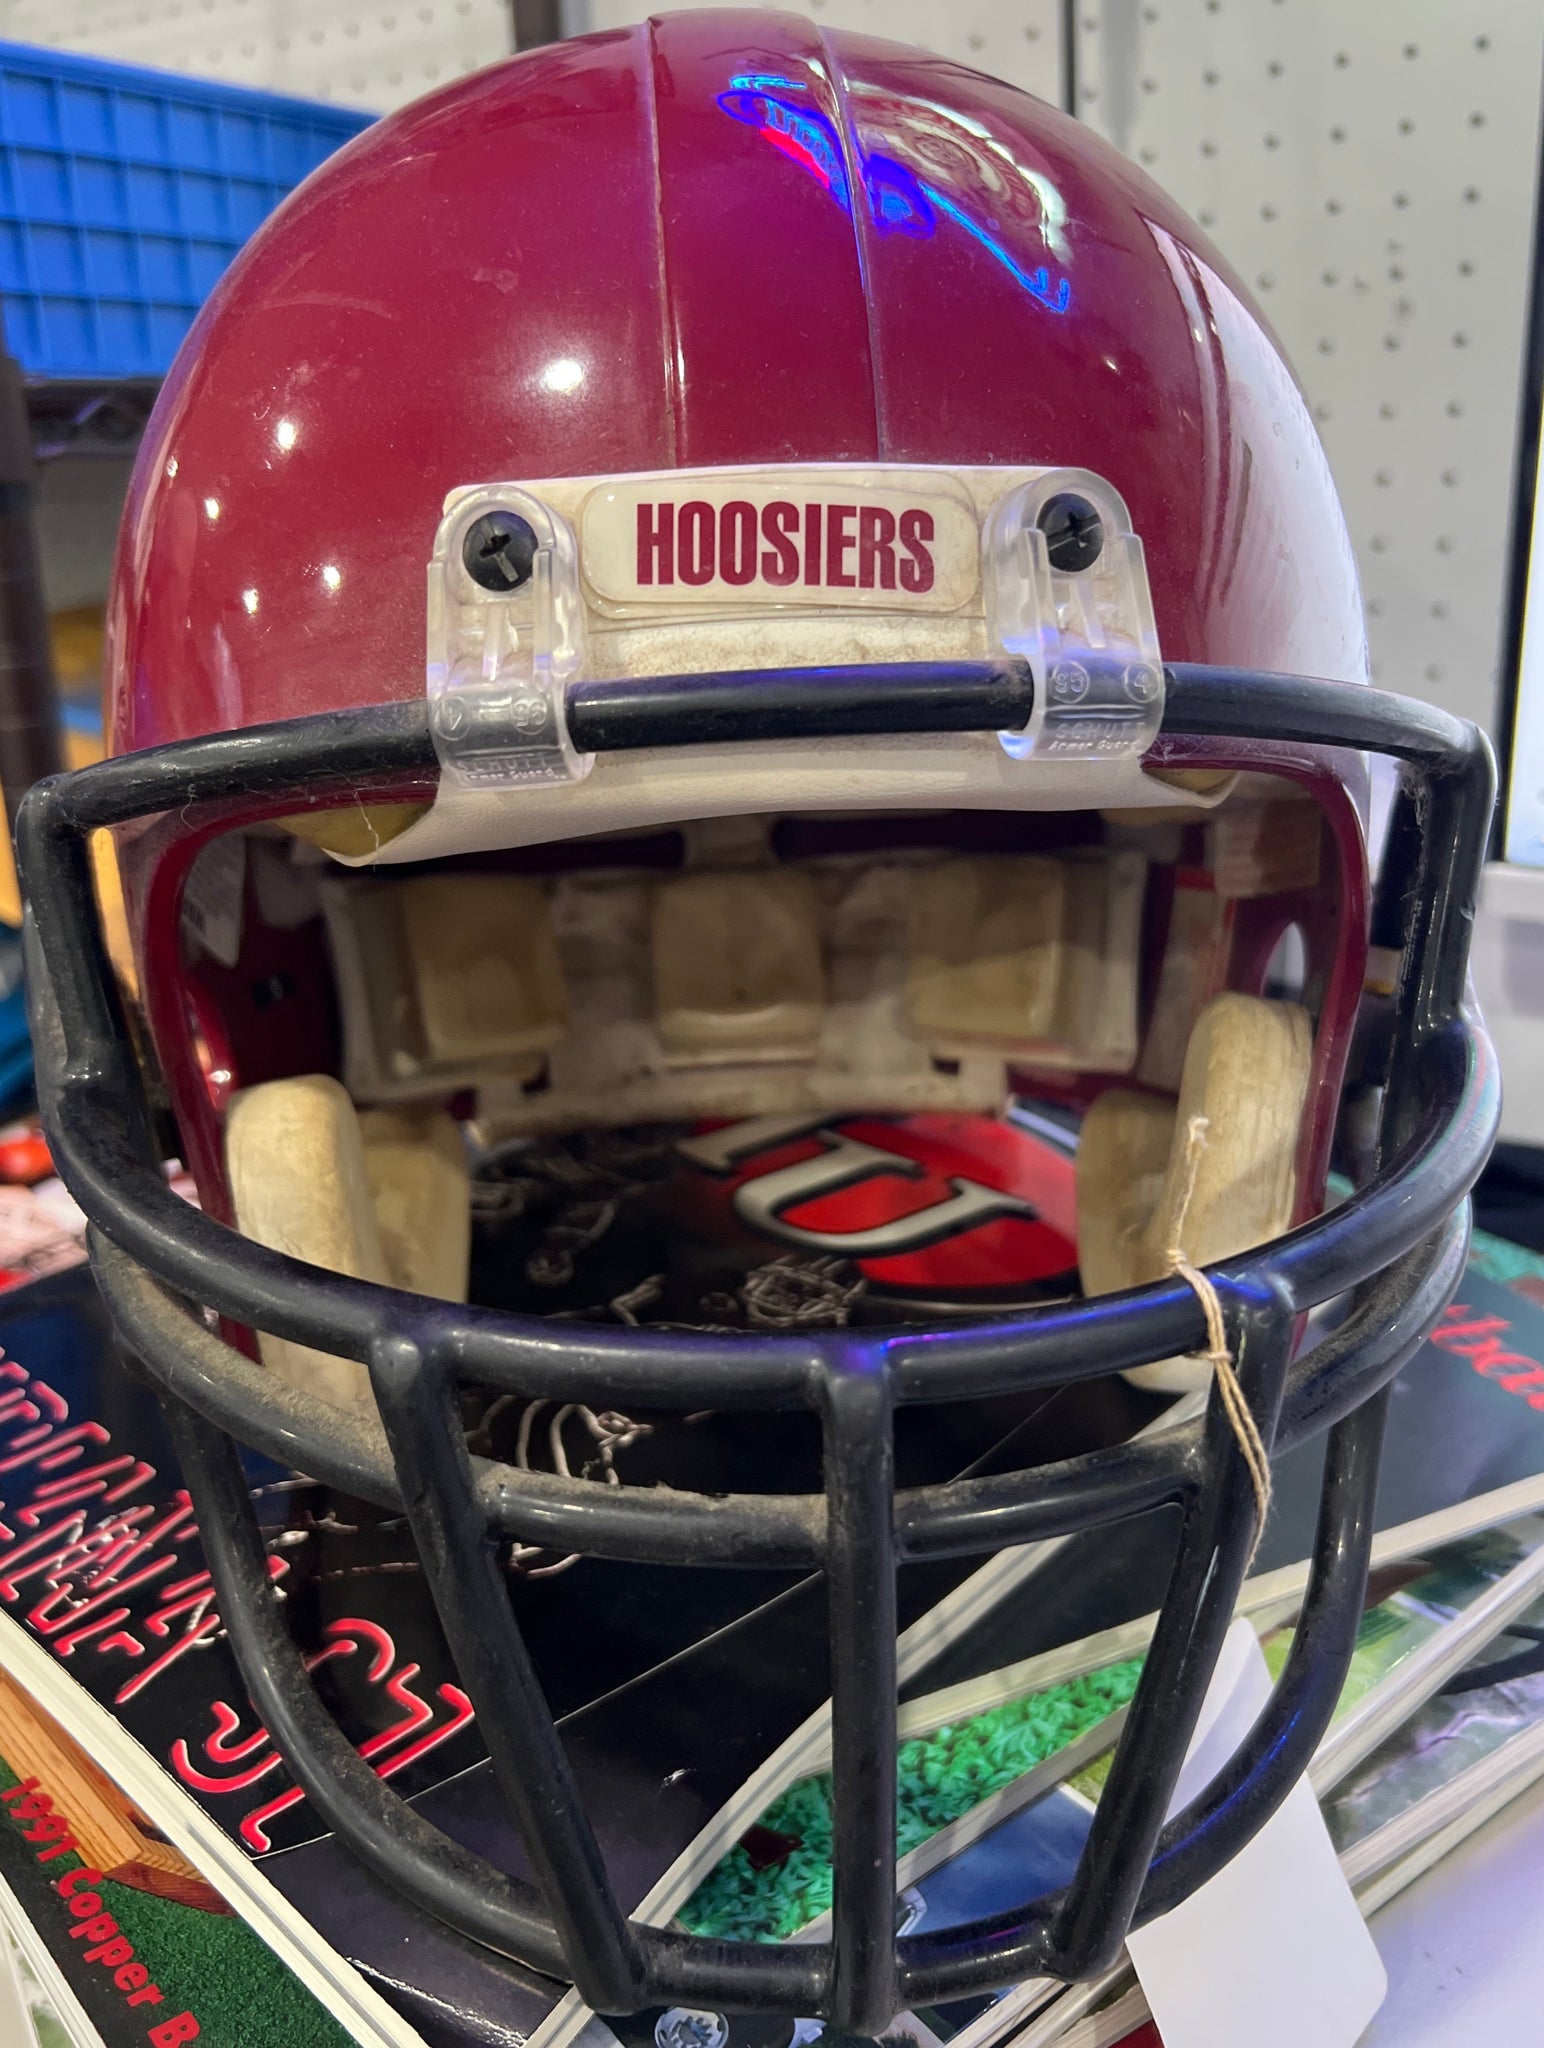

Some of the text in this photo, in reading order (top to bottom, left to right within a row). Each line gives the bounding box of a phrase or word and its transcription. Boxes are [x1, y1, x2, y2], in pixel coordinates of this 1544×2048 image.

[637, 501, 934, 593] HOOSIERS
[1055, 722, 1146, 739] SCHUTT
[0, 1776, 79, 1863] 1991
[57, 1867, 166, 2008] Copper
